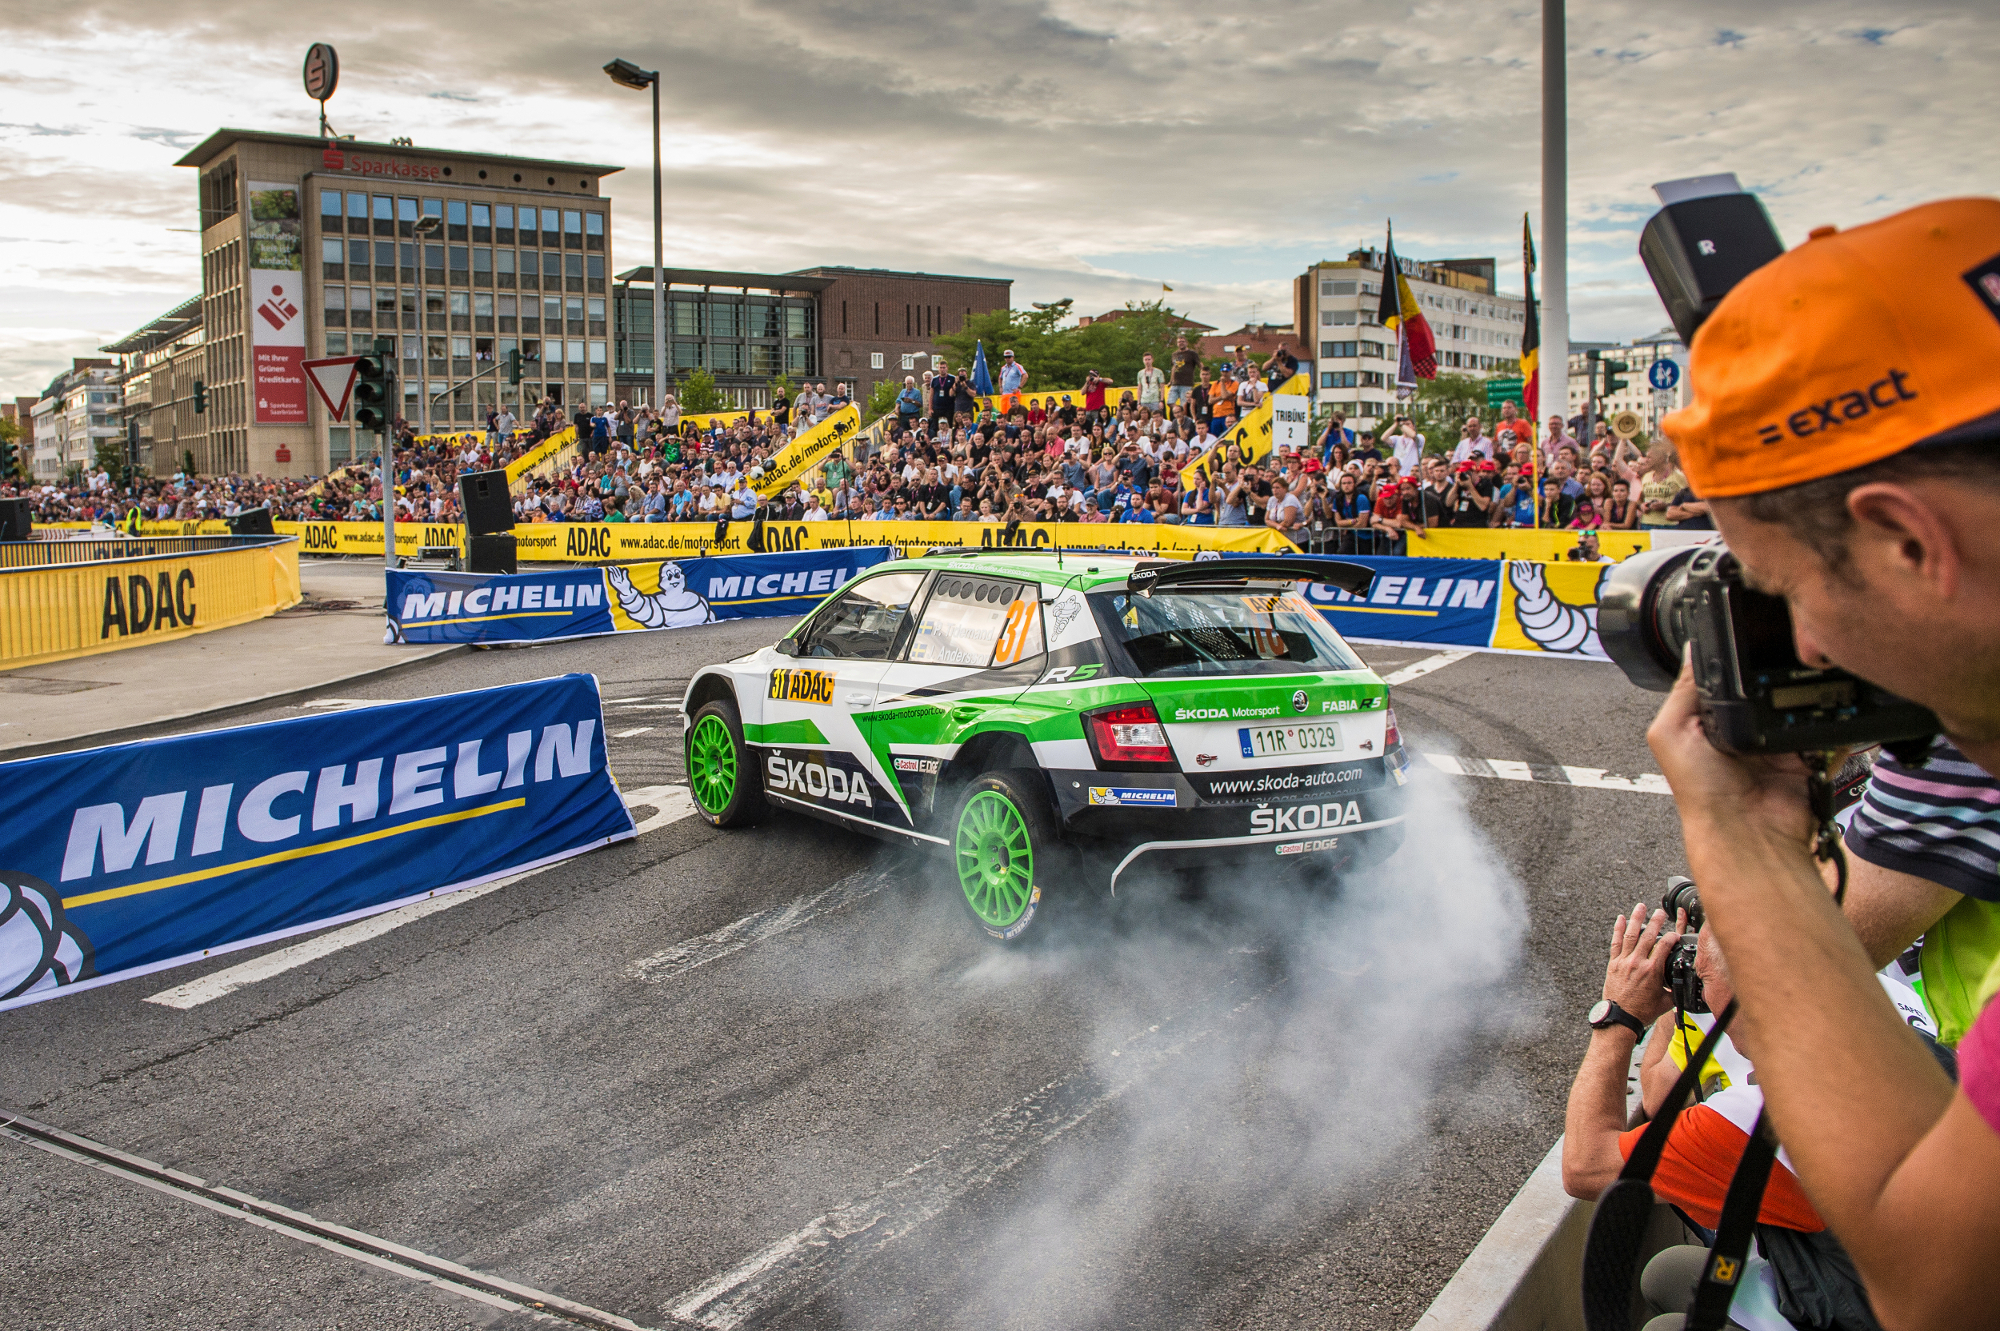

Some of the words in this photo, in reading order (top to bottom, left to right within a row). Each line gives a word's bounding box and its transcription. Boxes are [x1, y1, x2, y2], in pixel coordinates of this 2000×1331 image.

[351, 155, 440, 179] Sparkasse
[258, 354, 271, 362] Mit
[271, 354, 289, 362] Ihrer
[258, 364, 286, 373] Grünen
[1275, 408, 1306, 424] TRIBÜNE
[1287, 427, 1294, 439] 2
[304, 525, 338, 549] ADAC
[343, 532, 418, 545] www.adac.detorsport
[424, 527, 456, 549] ADAC
[567, 527, 611, 557] ADAC
[620, 534, 740, 551] www.adac.de/motorsport
[708, 567, 867, 599] MICHEL
[1297, 576, 1495, 609] CELIN
[101, 568, 196, 639] ADAC
[401, 584, 602, 619] MICHELIN
[1248, 597, 1296, 612] ADAC
[933, 622, 942, 636] P.
[946, 624, 995, 641] Tidemand
[995, 600, 1038, 663] 31
[938, 646, 989, 665] Andersson
[771, 669, 786, 699] 31
[1040, 663, 1104, 684] R5
[790, 671, 833, 702] ADAC
[1175, 708, 1229, 720] ŠKODA
[1232, 706, 1280, 718] Motorsport
[1322, 700, 1358, 712] FABIA
[1256, 729, 1287, 753] 11R
[1298, 727, 1336, 749] 0329
[767, 749, 873, 808] ŠKODA
[900, 759, 917, 770] Castrol
[920, 760, 939, 774] EDGE
[1210, 767, 1363, 795] www.skoda-auto.com
[60, 718, 597, 882] MICHELIN
[1121, 792, 1175, 800] MICHELIN
[1250, 801, 1362, 834] ŠKODA
[1282, 844, 1301, 855] Castrol
[1303, 838, 1338, 853] EDGE
